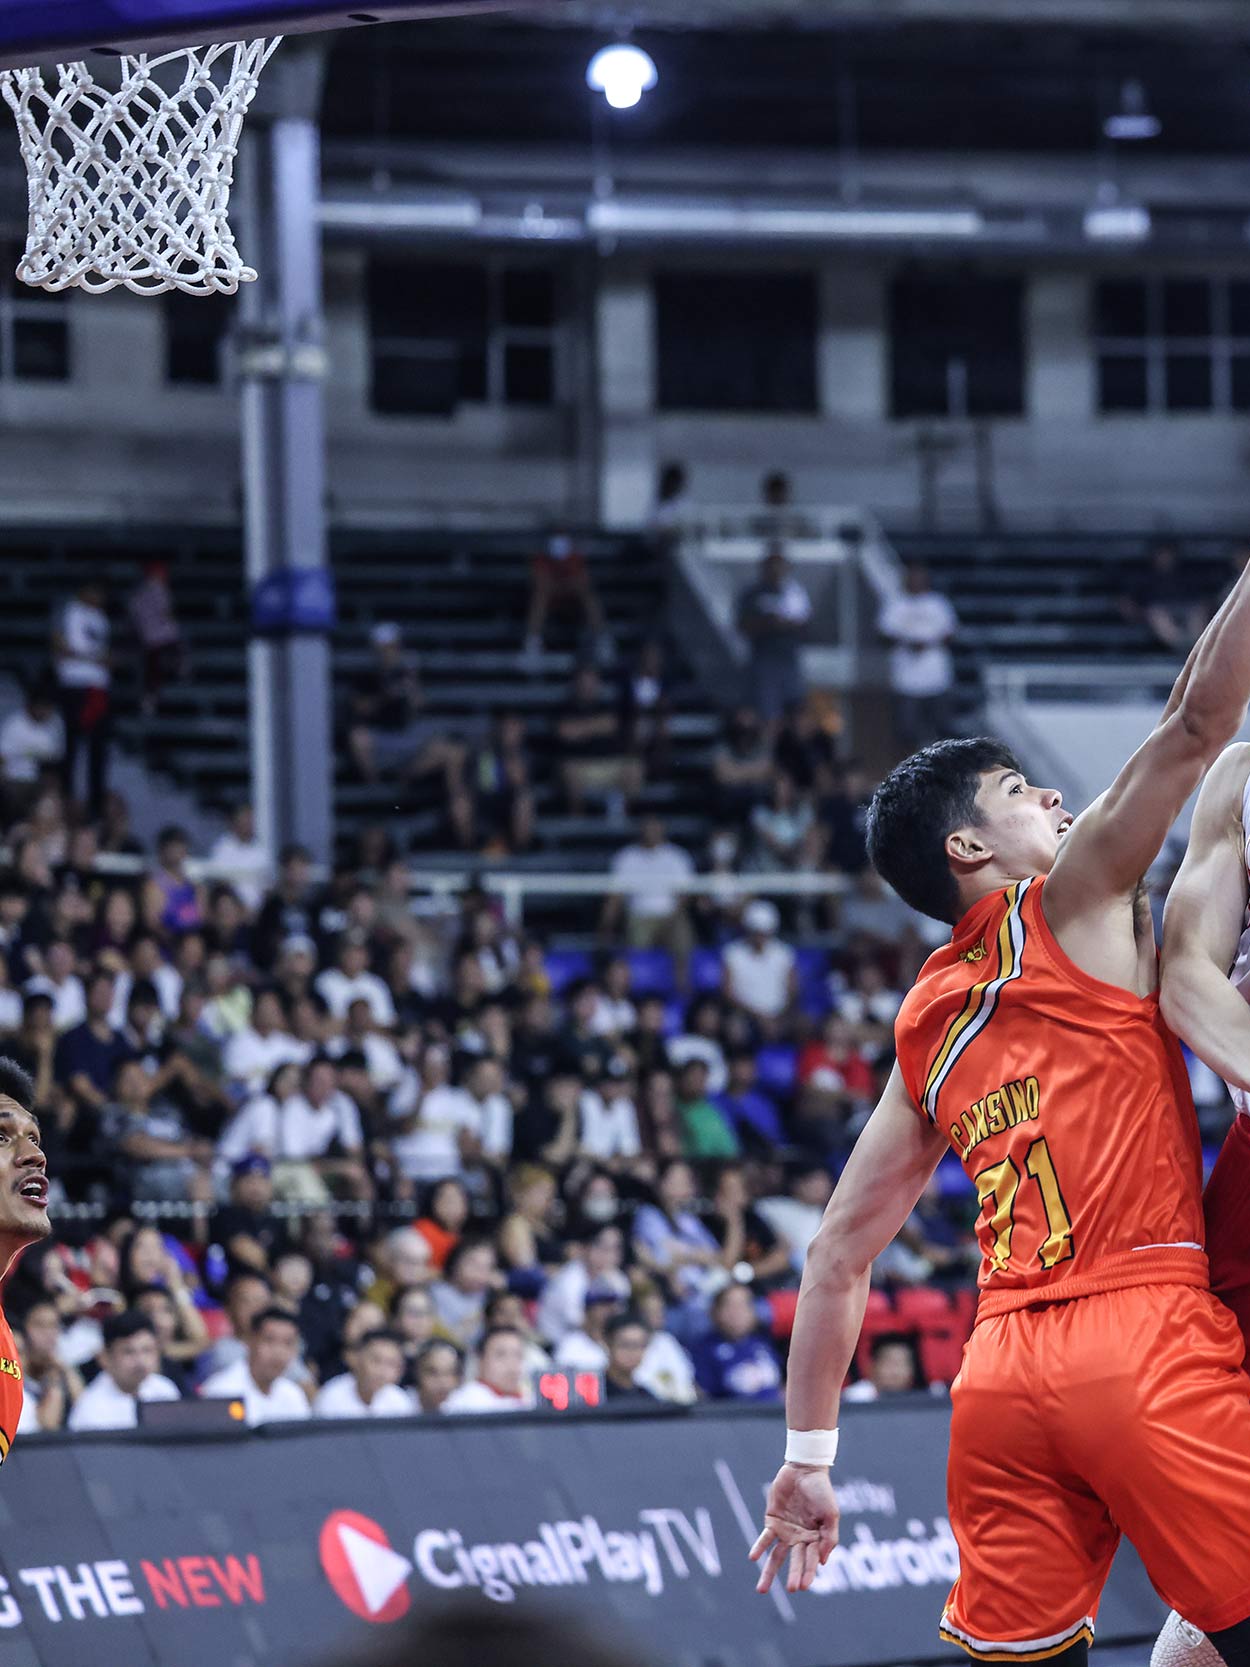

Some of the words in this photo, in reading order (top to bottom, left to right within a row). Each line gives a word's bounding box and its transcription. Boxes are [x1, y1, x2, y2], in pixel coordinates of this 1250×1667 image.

[950, 1075, 1041, 1163] CANSINO
[975, 1136, 1075, 1276] 71
[18, 1558, 145, 1623] THE
[140, 1552, 266, 1610] NEW
[413, 1507, 722, 1603] CignalPlayTV
